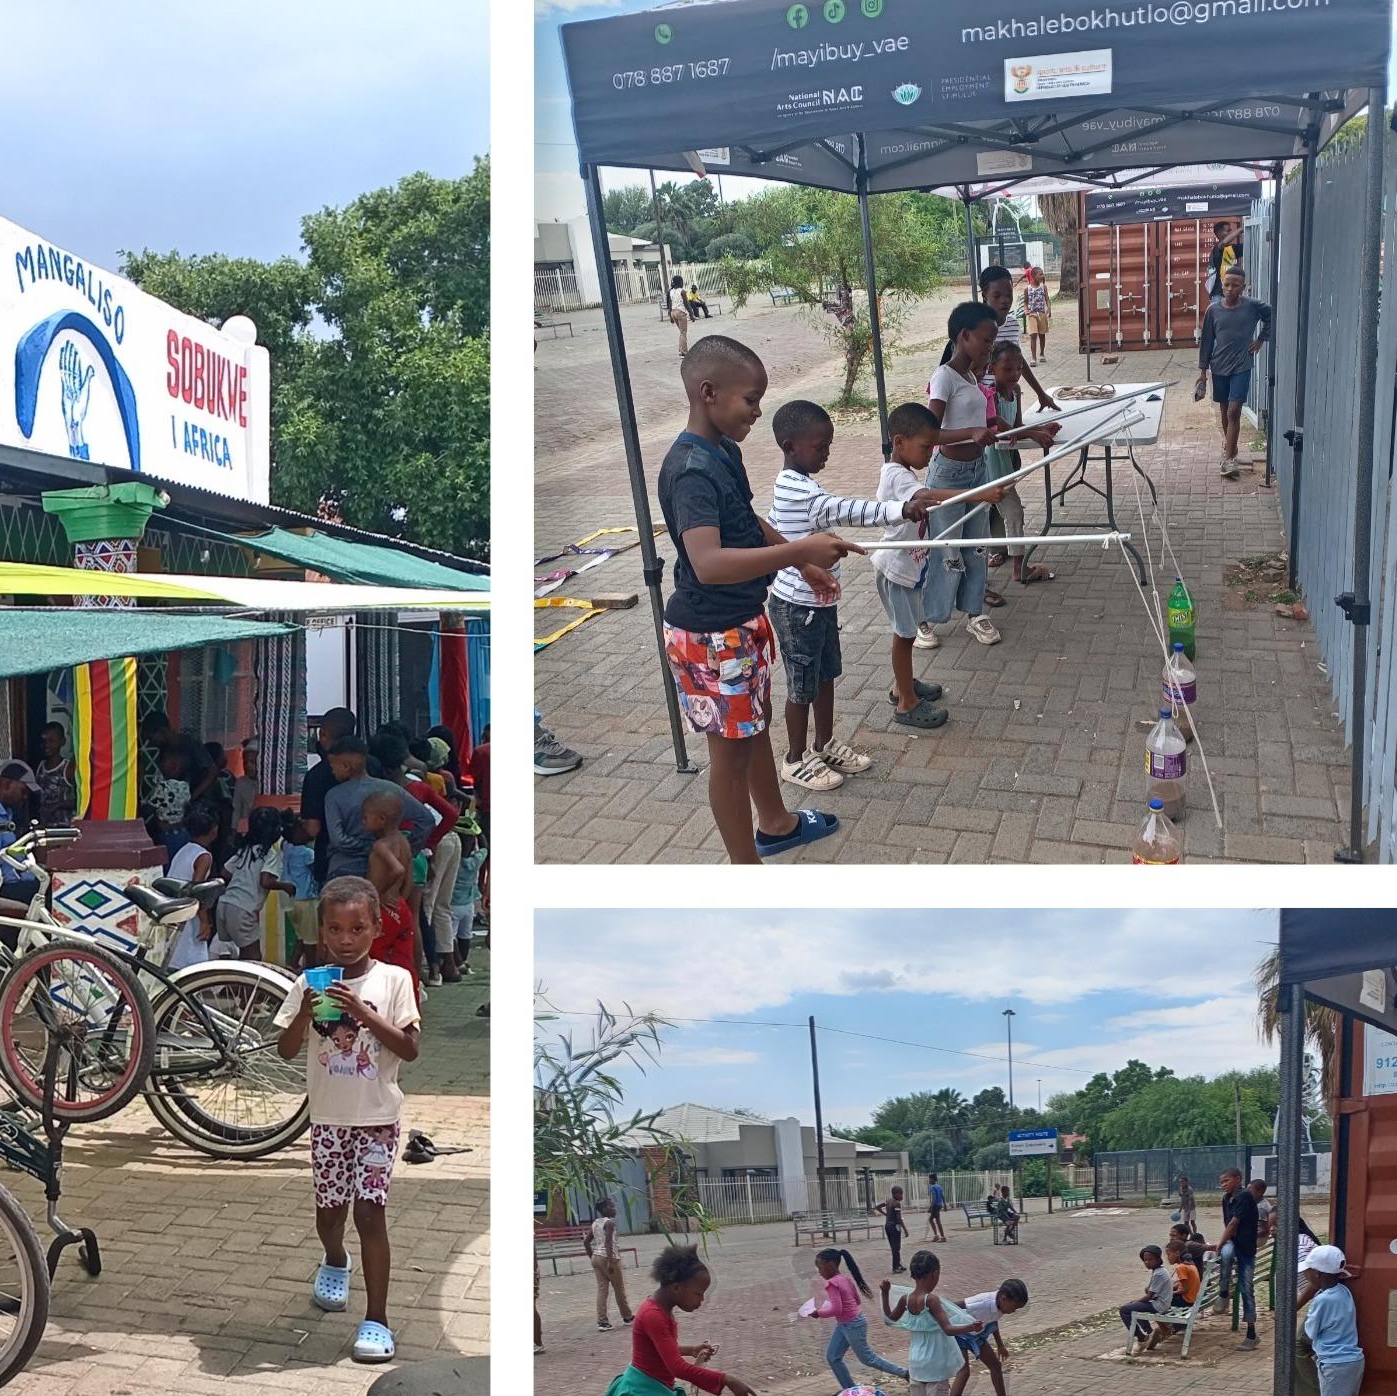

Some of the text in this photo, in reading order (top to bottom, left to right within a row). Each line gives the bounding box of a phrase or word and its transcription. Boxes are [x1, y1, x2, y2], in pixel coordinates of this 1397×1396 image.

[771, 35, 909, 70] /mayibuy_vae
[612, 58, 731, 90] 078 887 1687
[776, 103, 792, 111] Arts
[792, 100, 821, 110] Council
[788, 91, 820, 101] National
[15, 243, 125, 346] MANGALISO
[183, 420, 233, 471] AFRICA
